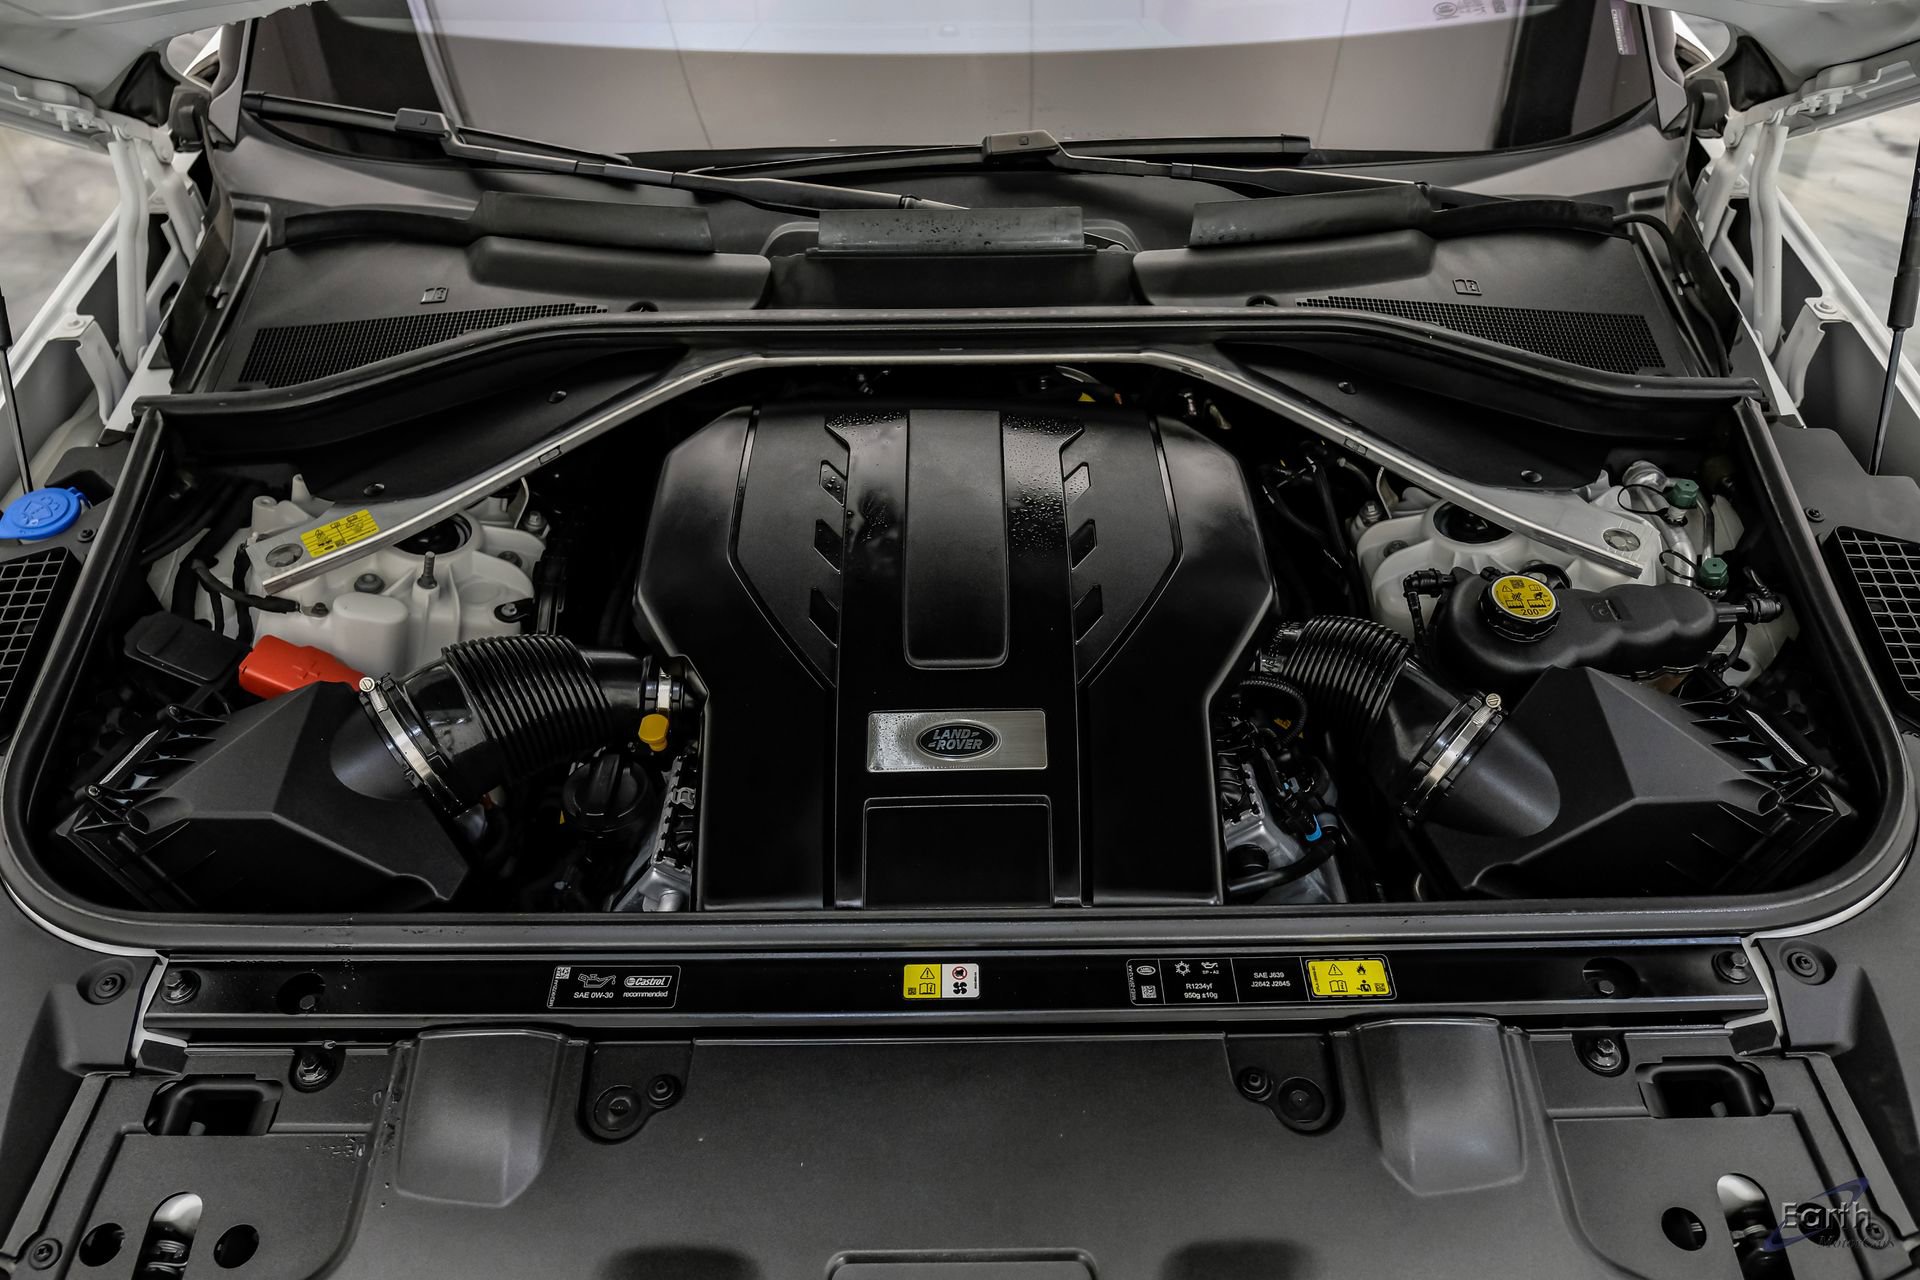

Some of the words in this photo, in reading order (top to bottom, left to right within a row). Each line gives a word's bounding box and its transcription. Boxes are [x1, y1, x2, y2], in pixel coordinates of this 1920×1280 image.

[933, 729, 971, 740] LAND
[936, 739, 983, 750] ROVER
[636, 977, 665, 986] Castrol
[573, 991, 590, 999] SAE
[591, 991, 614, 999] 0W-30
[623, 990, 668, 998] recommended
